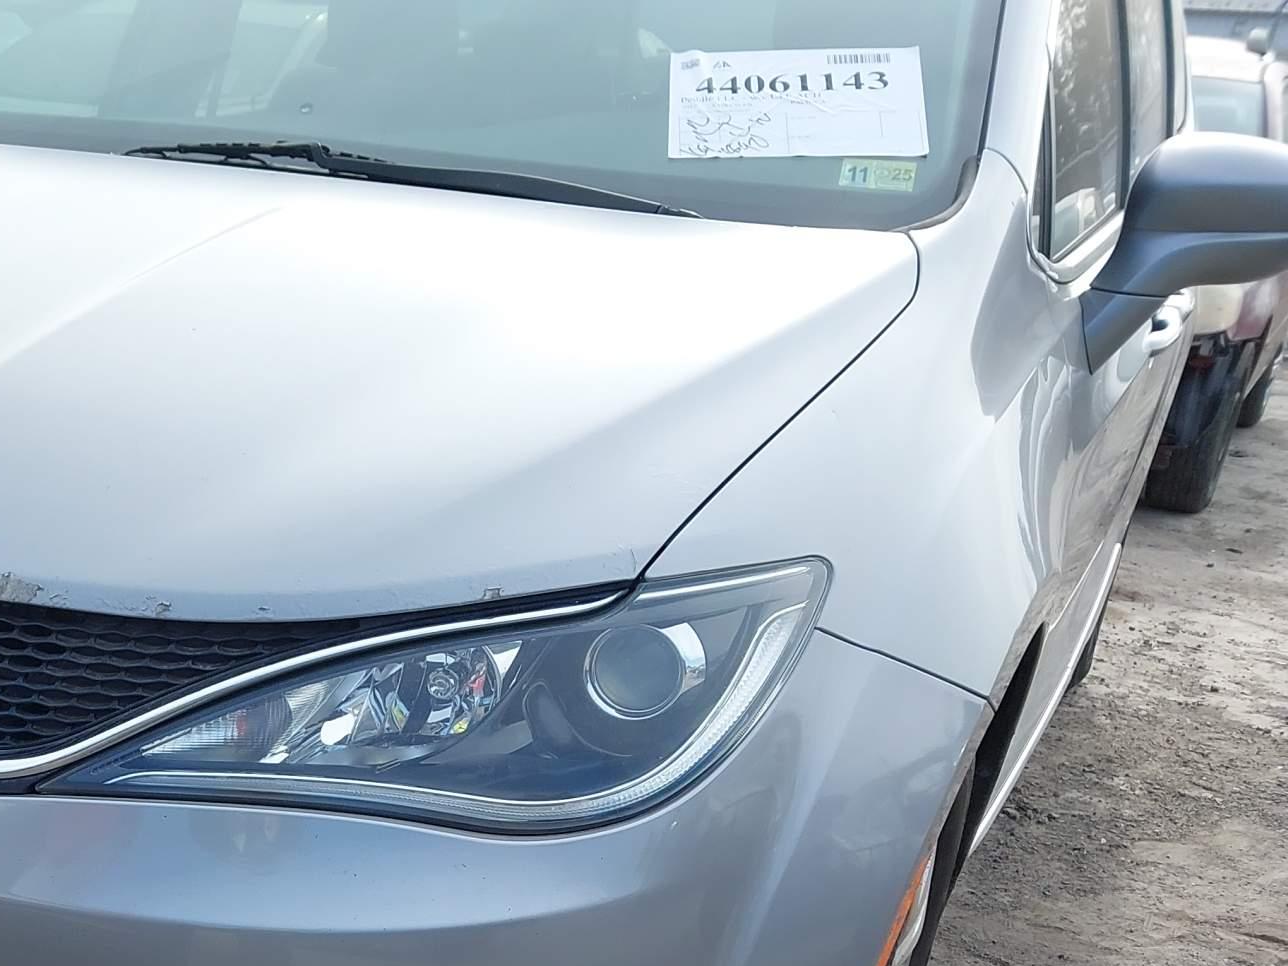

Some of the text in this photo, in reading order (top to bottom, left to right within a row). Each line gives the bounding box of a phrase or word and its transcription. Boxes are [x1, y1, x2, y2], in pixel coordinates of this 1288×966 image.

[696, 71, 889, 95] 44061143
[847, 166, 913, 183] 11 25
